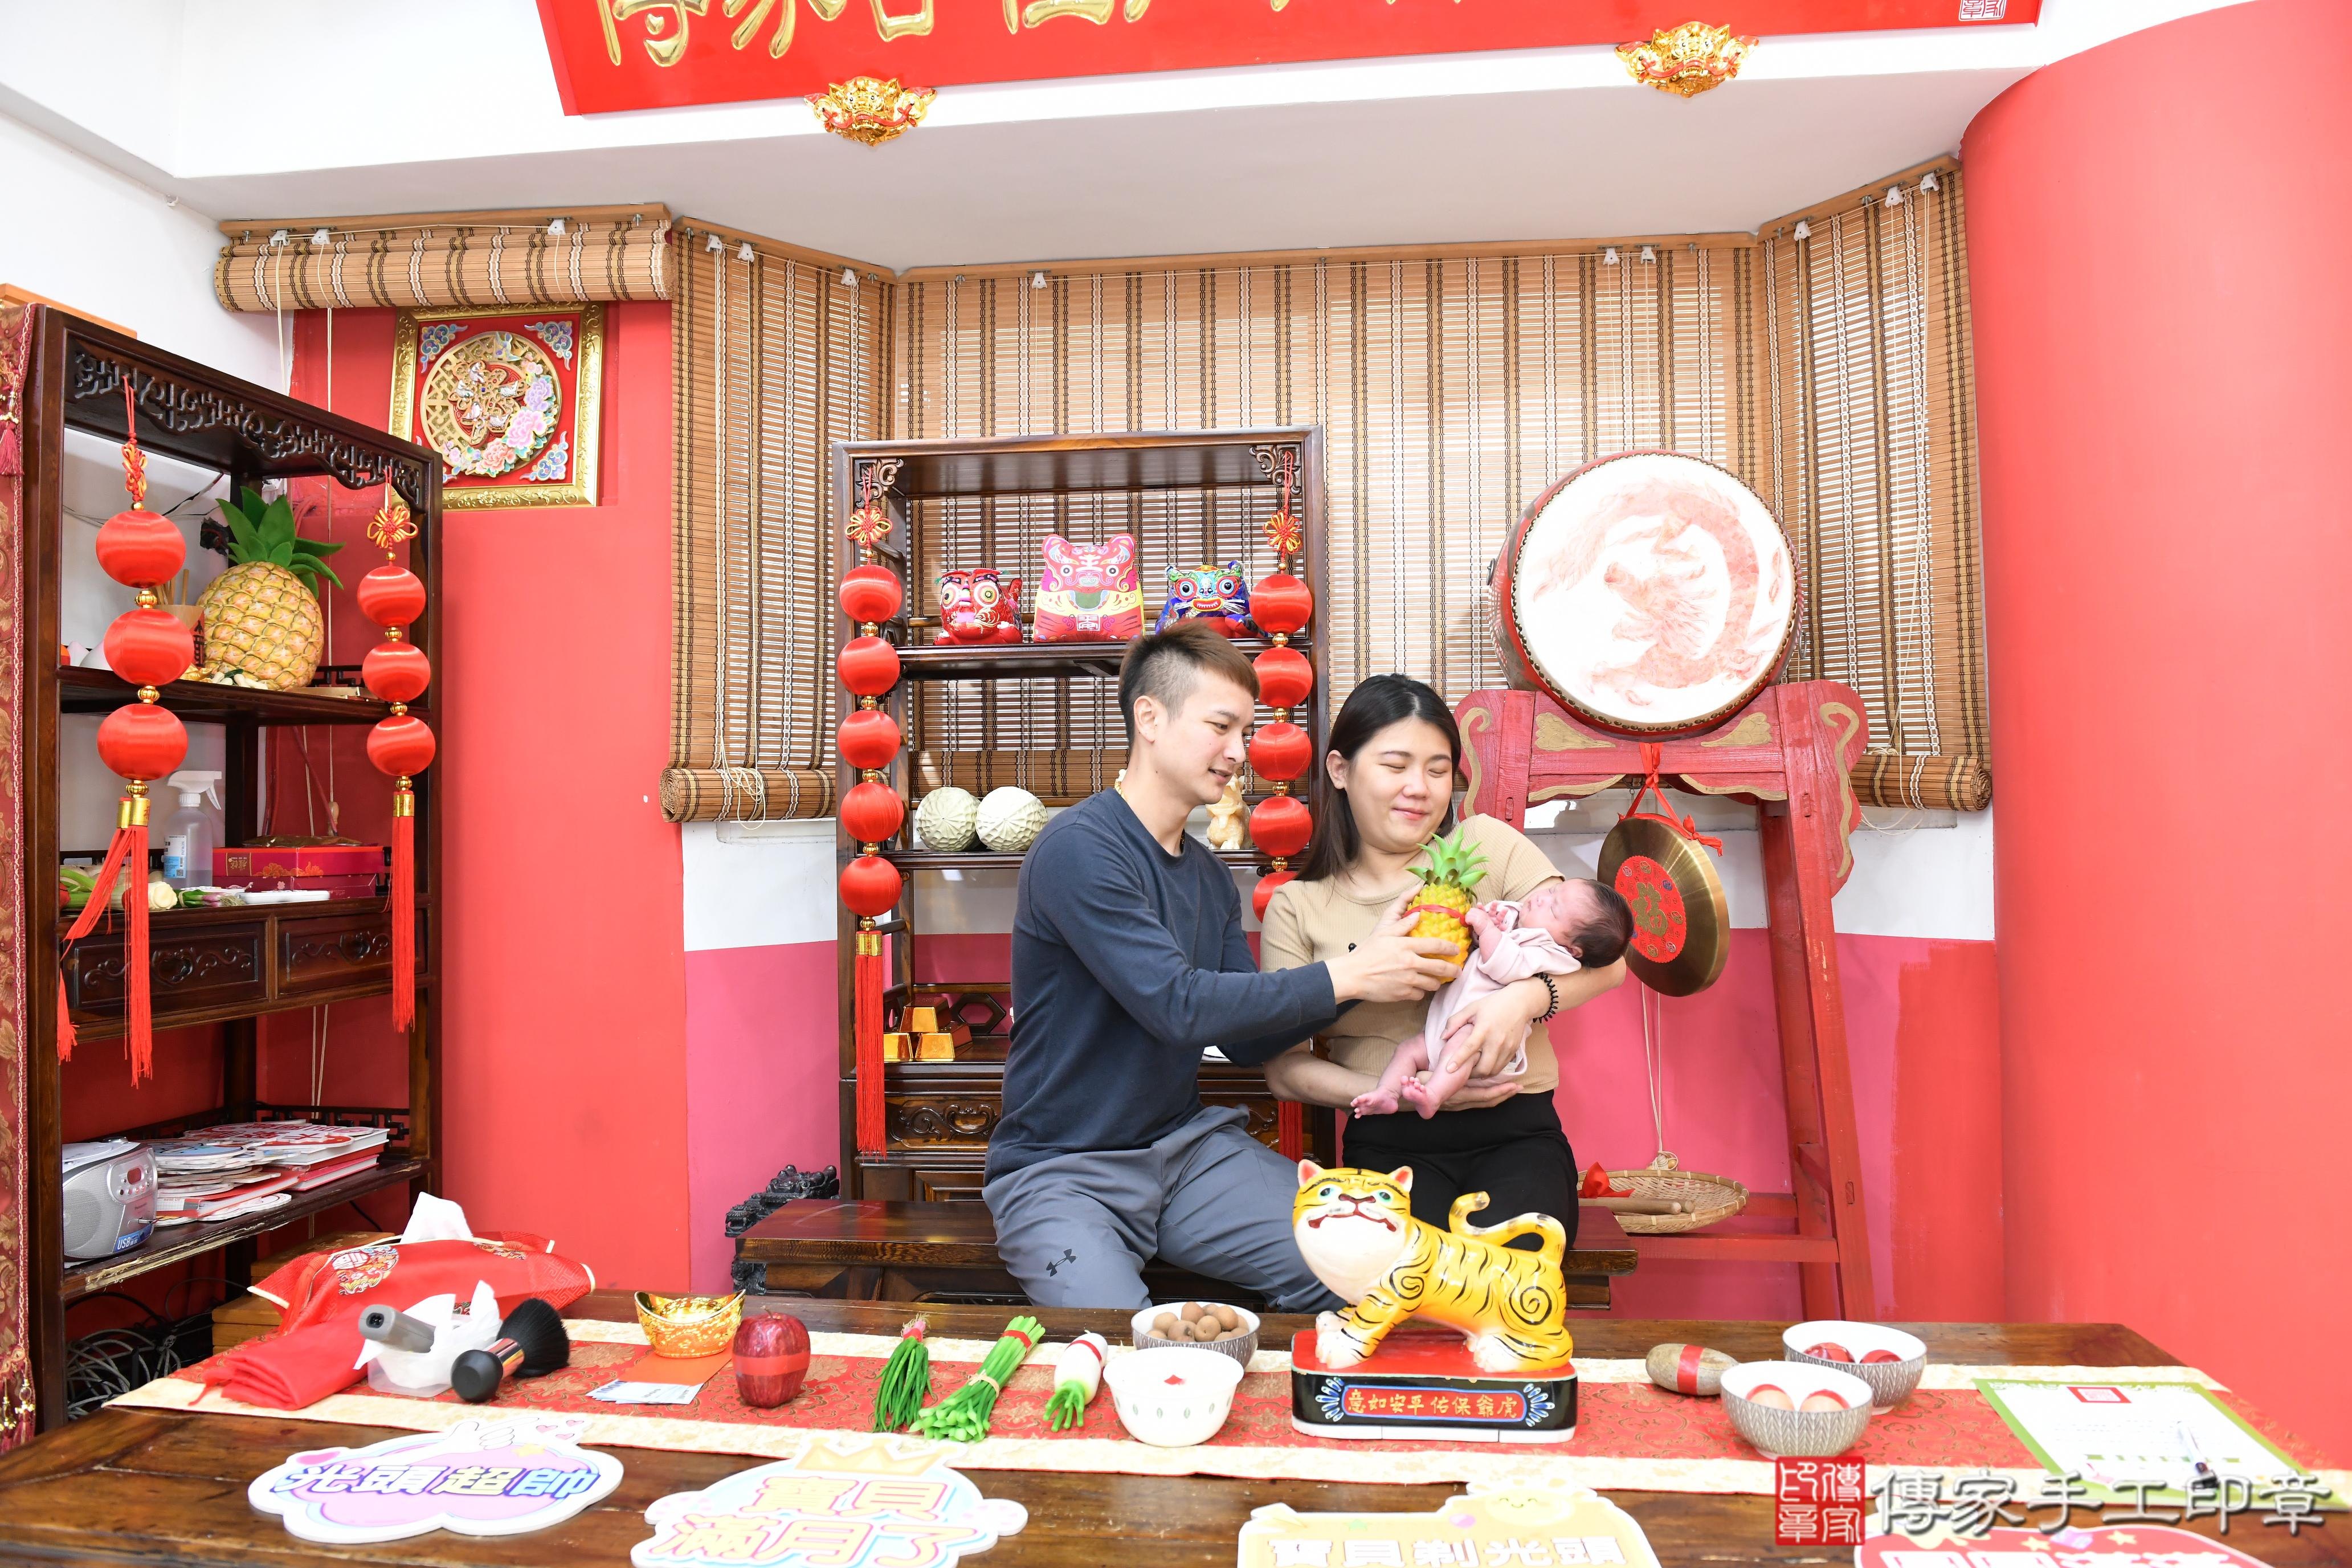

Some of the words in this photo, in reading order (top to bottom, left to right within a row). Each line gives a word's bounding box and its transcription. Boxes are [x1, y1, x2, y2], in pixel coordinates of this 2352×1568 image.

[117, 1237, 131, 1250] USB
[271, 1464, 601, 1498] 光頭超帥
[740, 1476, 948, 1521] 寶貝
[648, 1514, 979, 1567] 滿月了
[1268, 1537, 1627, 1568] 寶貝剃光頭
